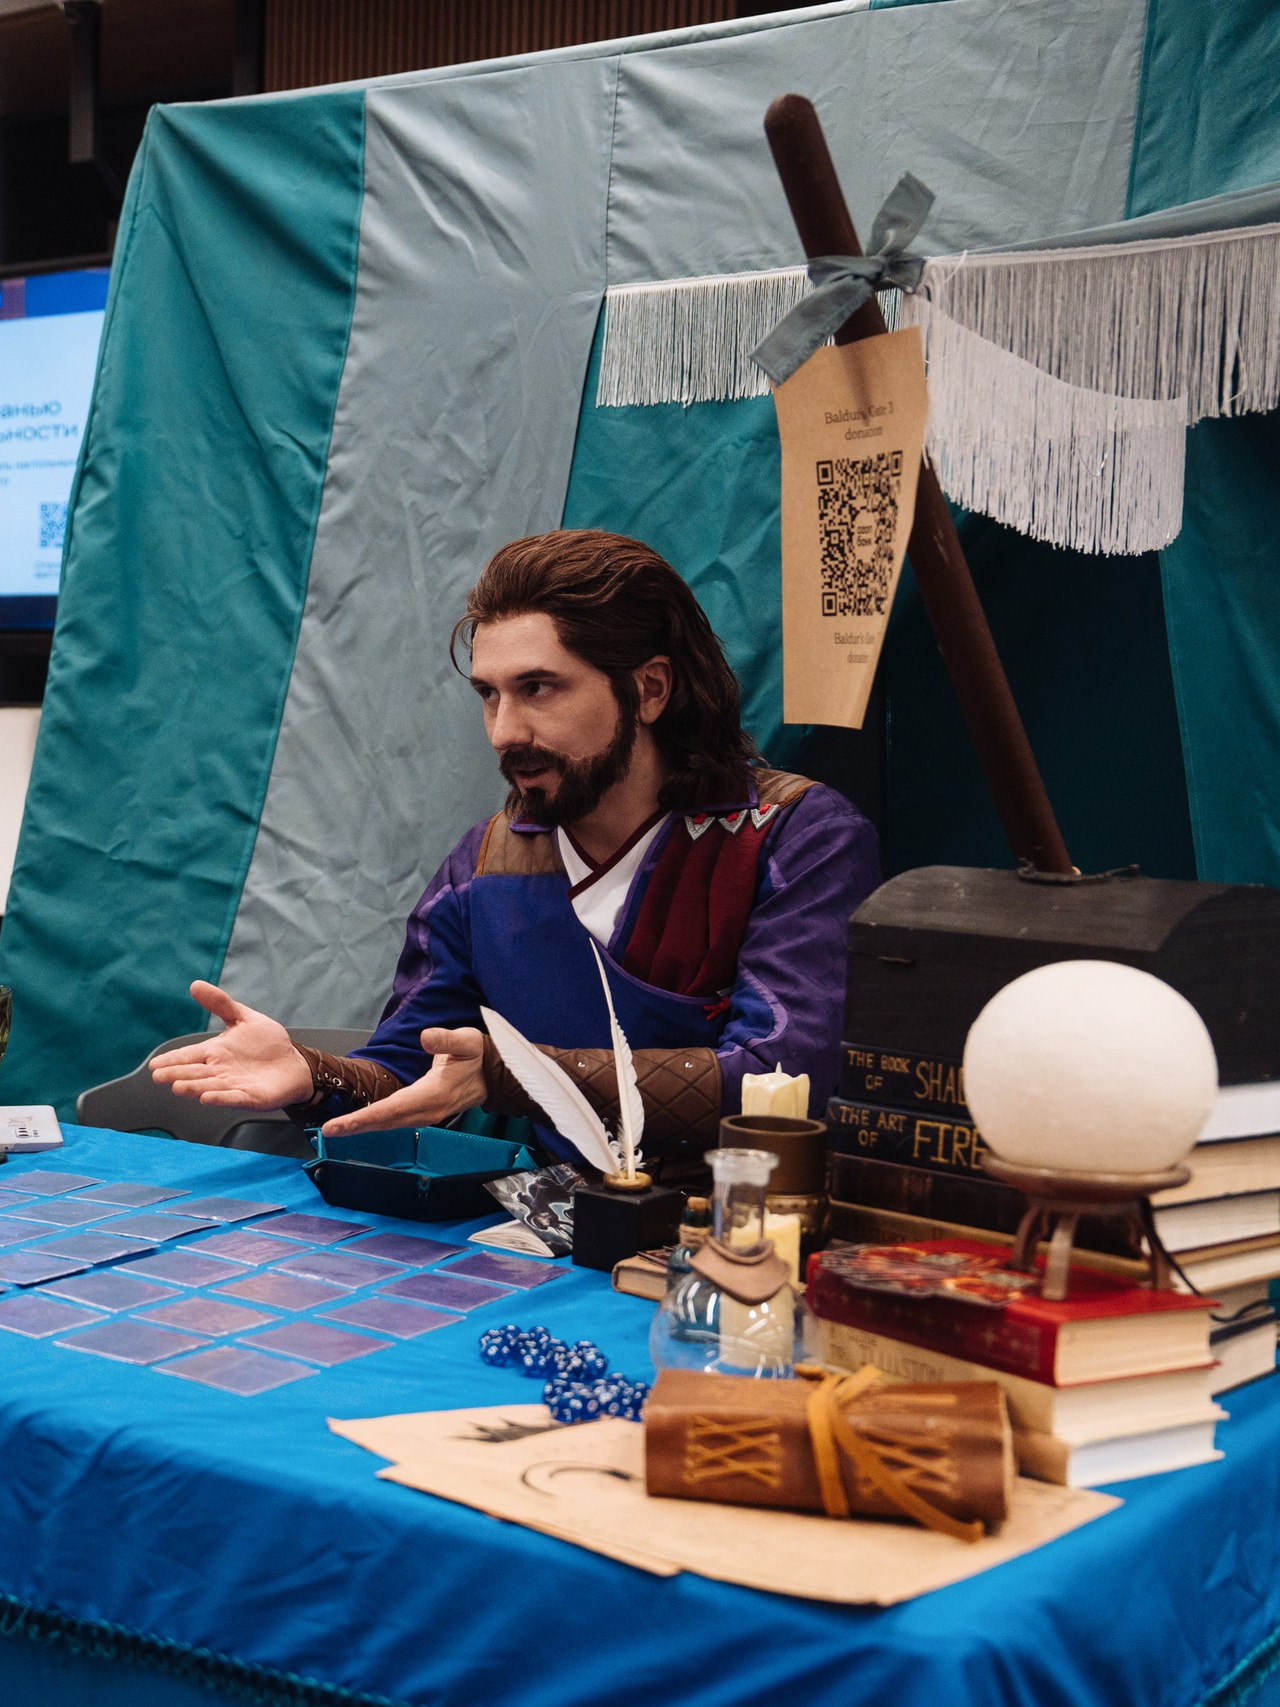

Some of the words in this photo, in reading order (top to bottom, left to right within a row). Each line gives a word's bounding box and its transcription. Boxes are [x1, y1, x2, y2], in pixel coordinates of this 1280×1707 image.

[848, 1050, 875, 1068] THE
[880, 1055, 910, 1073] BOOK
[865, 1074, 884, 1090] OF
[839, 1105, 870, 1126] THE
[877, 1111, 907, 1132] ART
[858, 1130, 879, 1148] OF
[912, 1119, 988, 1170] FIRE
